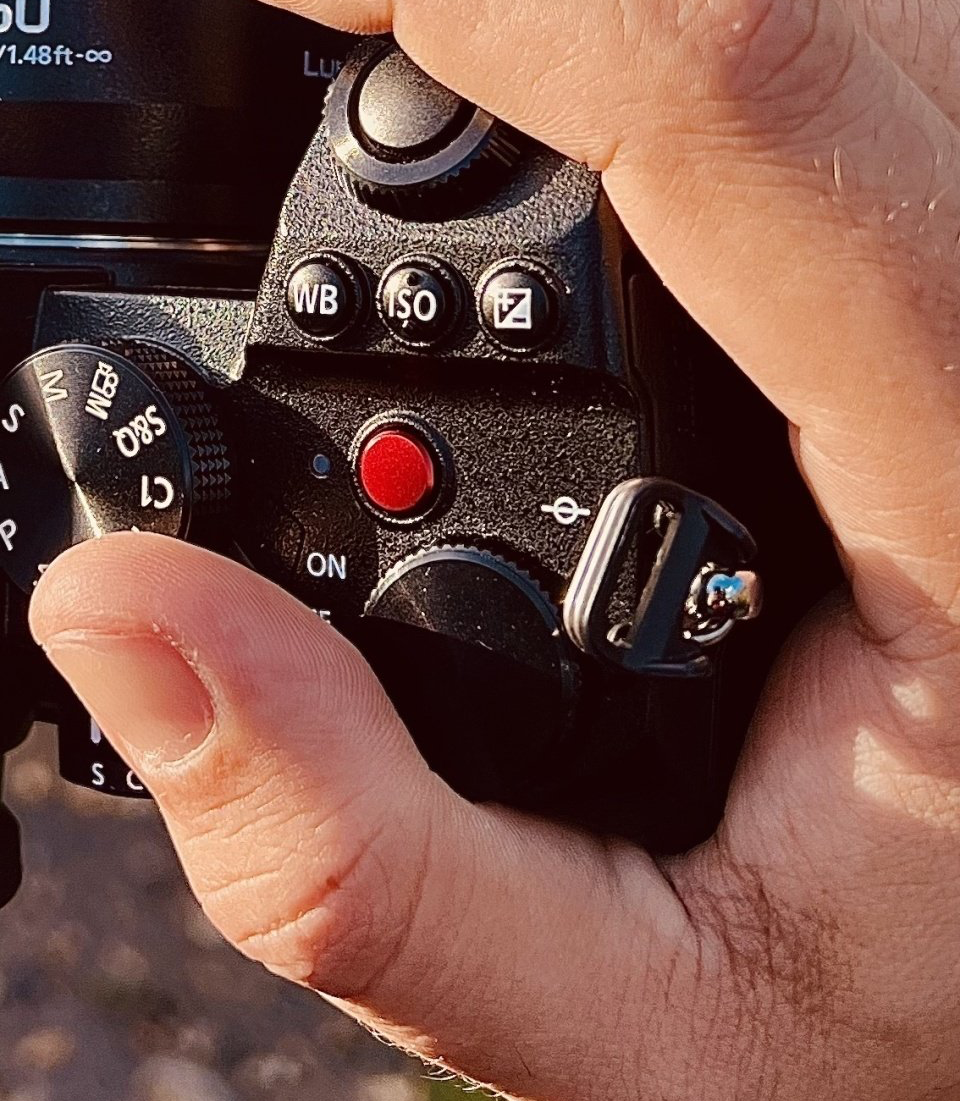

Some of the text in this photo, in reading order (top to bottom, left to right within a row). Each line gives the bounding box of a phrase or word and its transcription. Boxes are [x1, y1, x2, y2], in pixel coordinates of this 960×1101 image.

[303, 50, 342, 79] Lu
[293, 283, 339, 316] WB
[388, 288, 438, 322] ISO
[40, 369, 69, 402] M
[1, 403, 26, 433] S
[112, 404, 167, 458] S&Q
[140, 475, 175, 510] C1
[306, 552, 347, 580] ON
[91, 762, 105, 786] S
